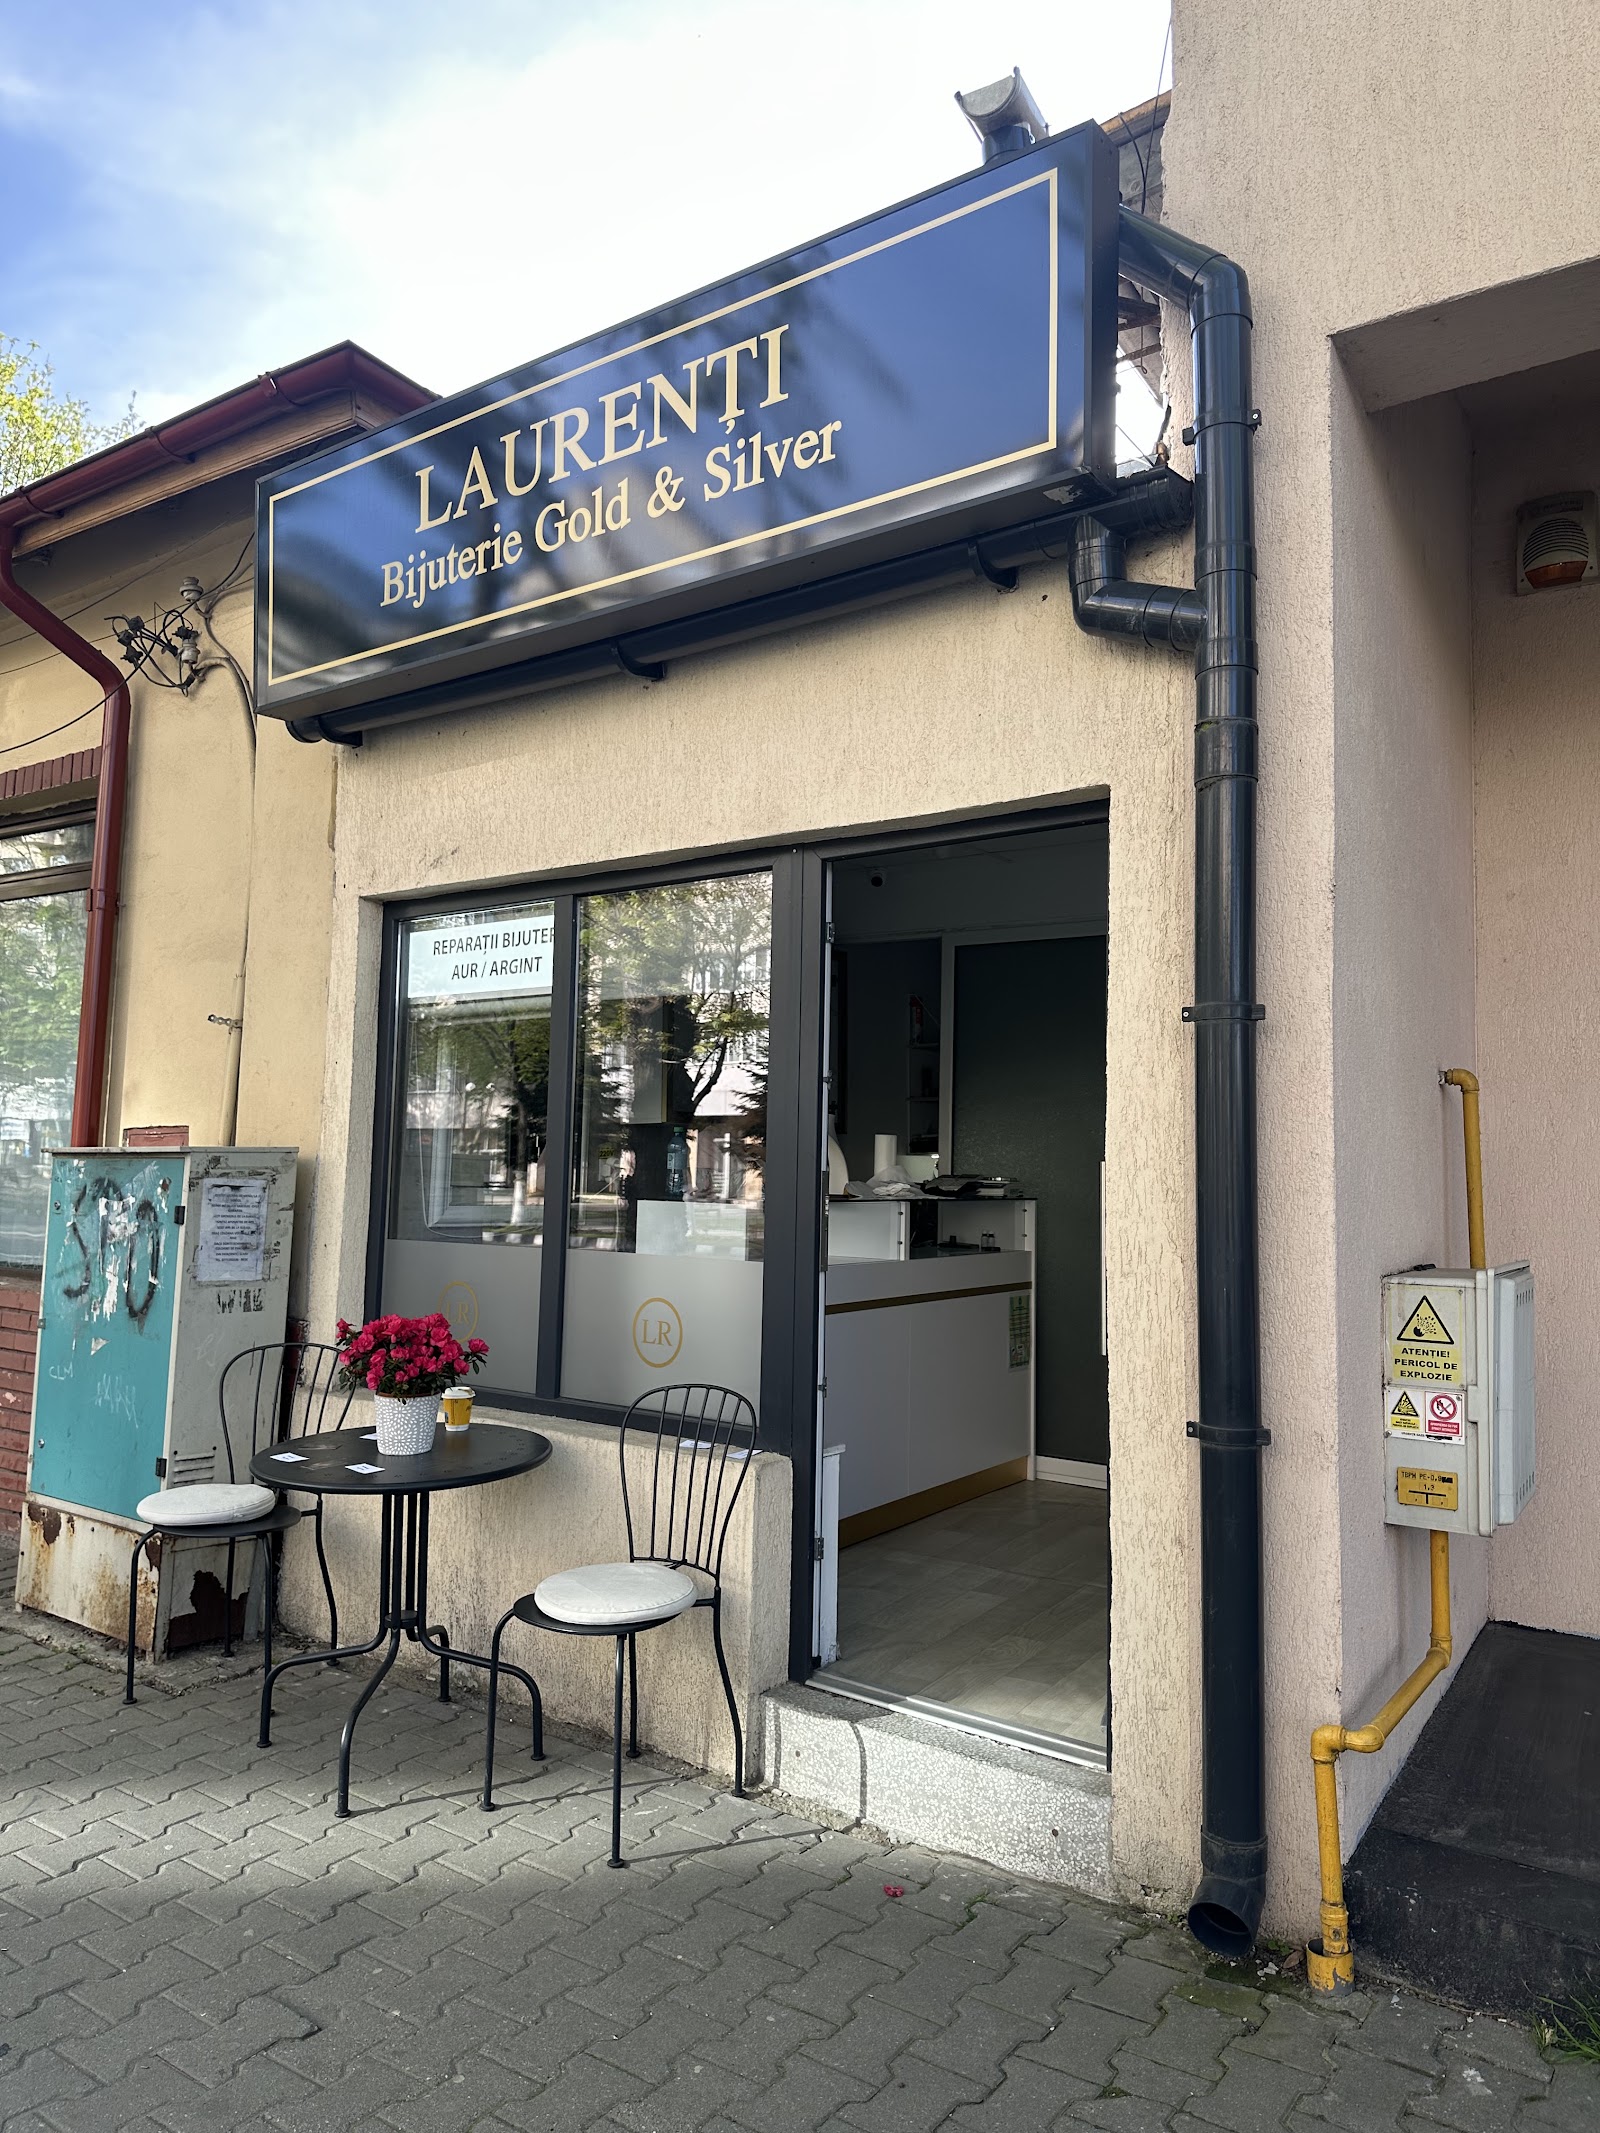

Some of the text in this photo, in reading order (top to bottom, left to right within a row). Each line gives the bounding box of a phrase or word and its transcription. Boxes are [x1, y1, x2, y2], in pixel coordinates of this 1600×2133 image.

[414, 323, 789, 533] LAURENȚI
[380, 420, 843, 609] Bijuterie Gold & Silver
[432, 933, 499, 956] REPARAȚII
[451, 956, 543, 980] AUR / ARGINT
[641, 1318, 673, 1347] LR
[1394, 1358, 1458, 1370] PERICOL DE
[1401, 1347, 1450, 1359] ATENȚIE!
[1400, 1370, 1453, 1381] EXPLOZIE
